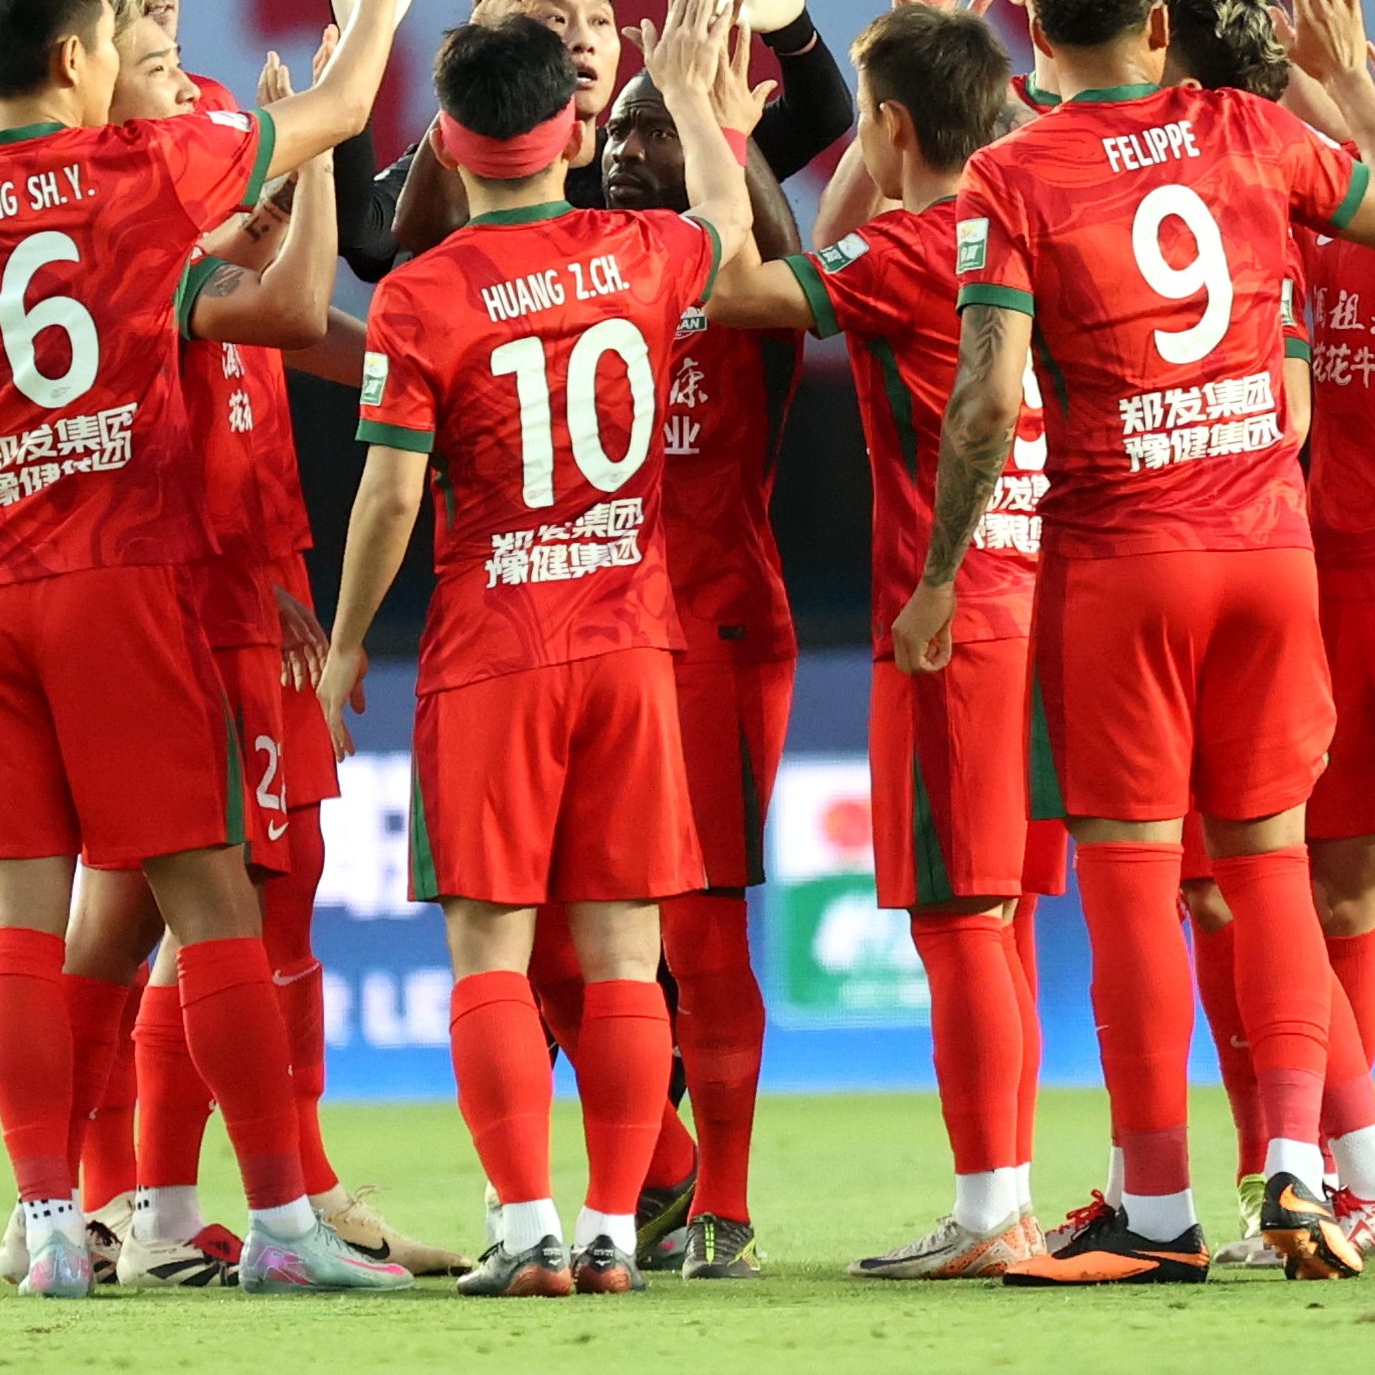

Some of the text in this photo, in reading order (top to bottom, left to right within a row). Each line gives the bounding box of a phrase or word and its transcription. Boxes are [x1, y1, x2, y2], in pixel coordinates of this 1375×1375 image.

[1102, 121, 1200, 172] FELIPPE
[30, 165, 96, 208] SH.Y.
[482, 255, 630, 322] HUANG Z.CH.
[1132, 184, 1233, 365] 9
[491, 318, 655, 508] 10
[1119, 371, 1275, 435] 郑发集团
[1123, 412, 1284, 473] 豫健集团
[491, 497, 644, 558] 郑发集团
[485, 529, 643, 588] 豫健集团
